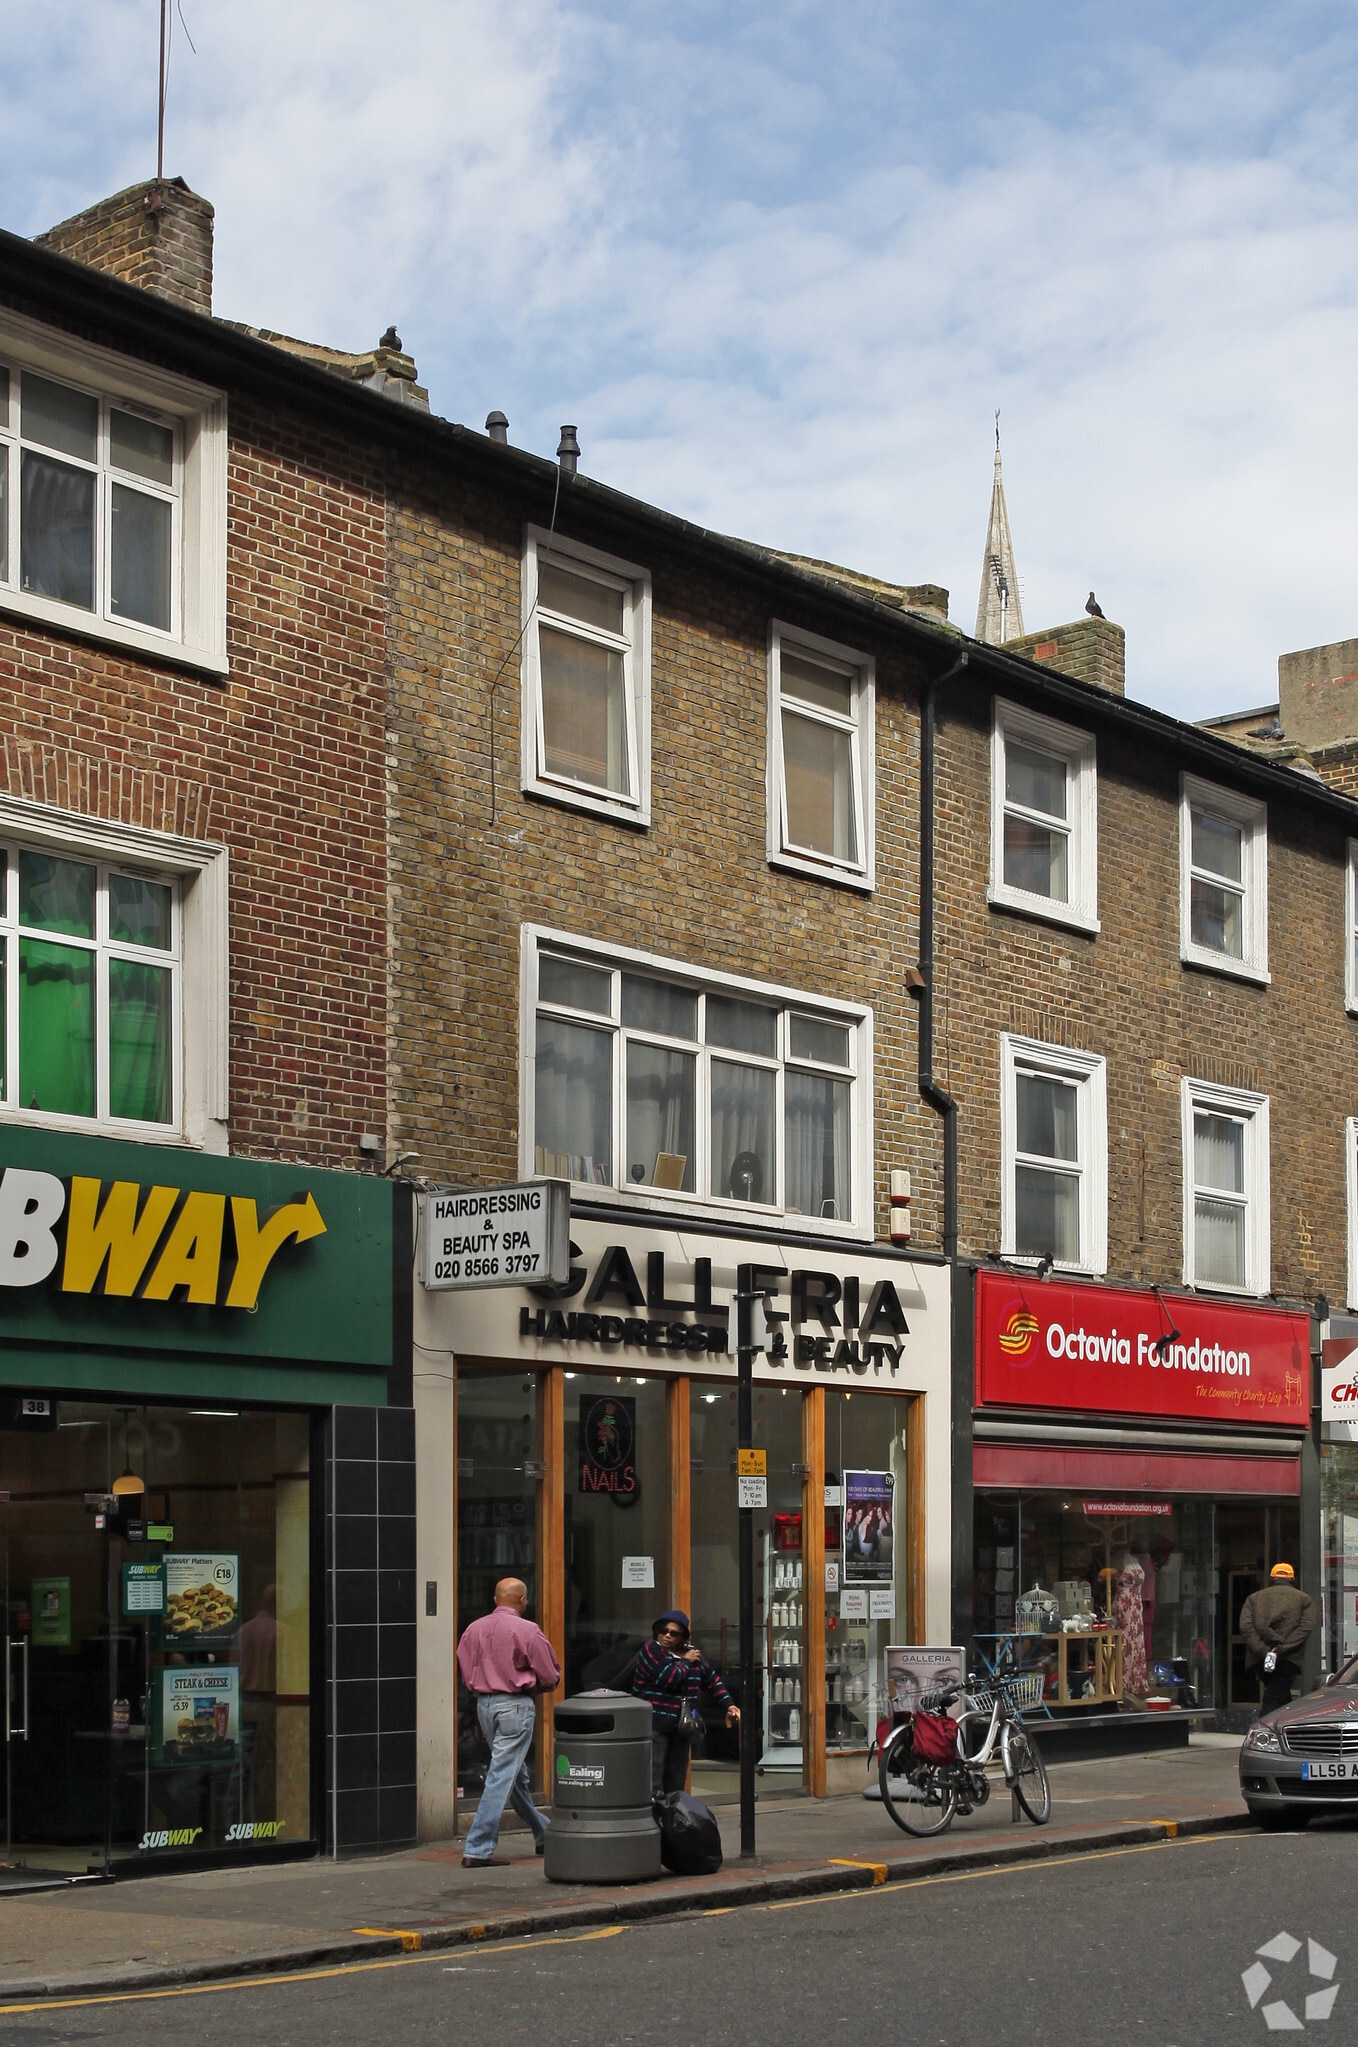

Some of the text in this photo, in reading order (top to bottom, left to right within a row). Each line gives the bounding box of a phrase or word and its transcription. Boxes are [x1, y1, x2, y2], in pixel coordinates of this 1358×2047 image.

[435, 1192, 541, 1219] HAIRDRESSING
[483, 1219, 494, 1231] &
[443, 1231, 531, 1256] BEAUTY SPA
[434, 1253, 540, 1279] 020 8566 3797
[519, 1306, 906, 1370] HAIRDRESSIN & BEAUTY
[1046, 1322, 1251, 1377] Octavia Foundation
[1195, 1384, 1282, 1408] The Community Charity Shop
[1331, 1383, 1358, 1402] Ch
[28, 1401, 45, 1413] 38
[582, 1464, 635, 1492] NAILS
[1087, 1502, 1169, 1514] www.octaviafoundation.org.uk
[128, 1564, 161, 1575] SUBWAY
[216, 1569, 231, 1579] £18
[901, 1654, 951, 1663] GALLERIA
[174, 1677, 229, 1689] STEAK & CHEESE
[570, 1767, 603, 1779] Ealing
[1310, 1764, 1346, 1778] LL58
[138, 1826, 203, 1850] SUBWAY
[225, 1819, 286, 1841] SUBWAY
